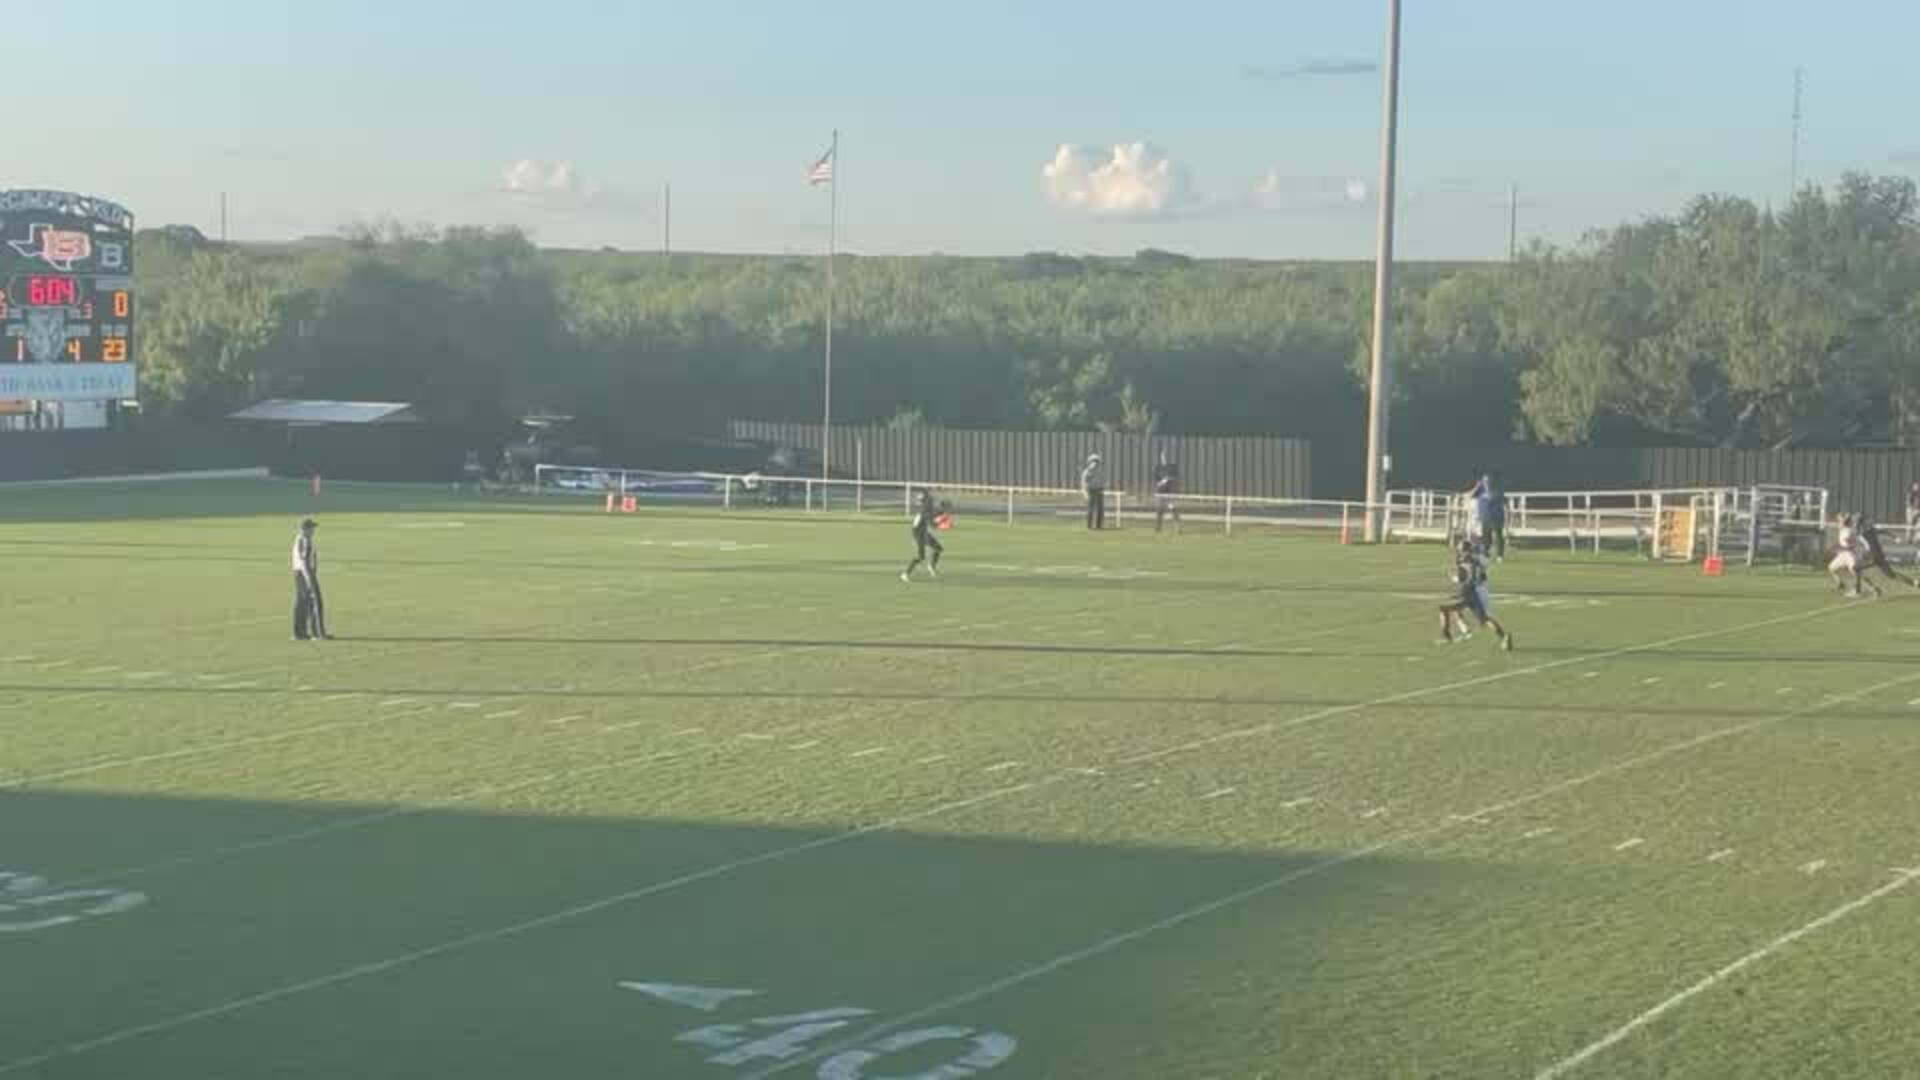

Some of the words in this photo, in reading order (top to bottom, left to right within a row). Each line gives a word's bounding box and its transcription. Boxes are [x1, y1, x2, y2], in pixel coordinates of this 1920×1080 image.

[114, 291, 128, 318] 0
[67, 339, 80, 361] 4
[103, 338, 126, 361] 23
